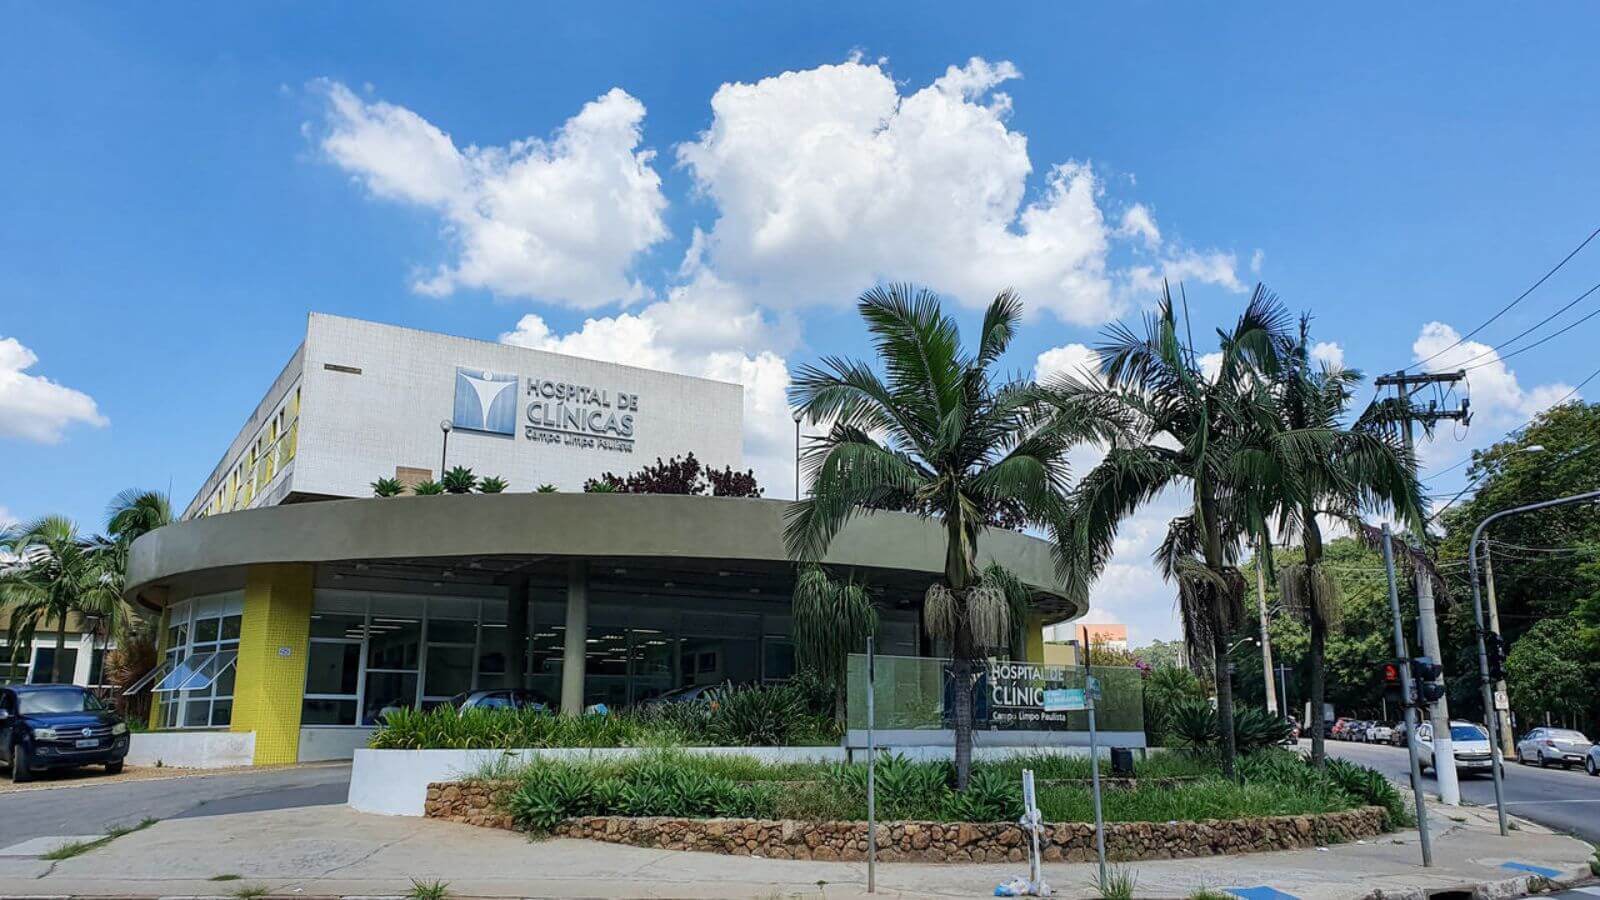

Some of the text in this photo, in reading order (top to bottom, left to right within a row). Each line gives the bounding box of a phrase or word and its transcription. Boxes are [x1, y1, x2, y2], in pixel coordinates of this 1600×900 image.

[527, 378, 638, 412] HOSPITAL DE
[527, 400, 634, 437] CLÍNICAS
[525, 430, 561, 444] Campo
[564, 434, 594, 450] Limpo
[992, 665, 1045, 681] HOSPITAL
[992, 682, 1044, 706] CLÍNIC
[1018, 711, 1040, 722] Limpo
